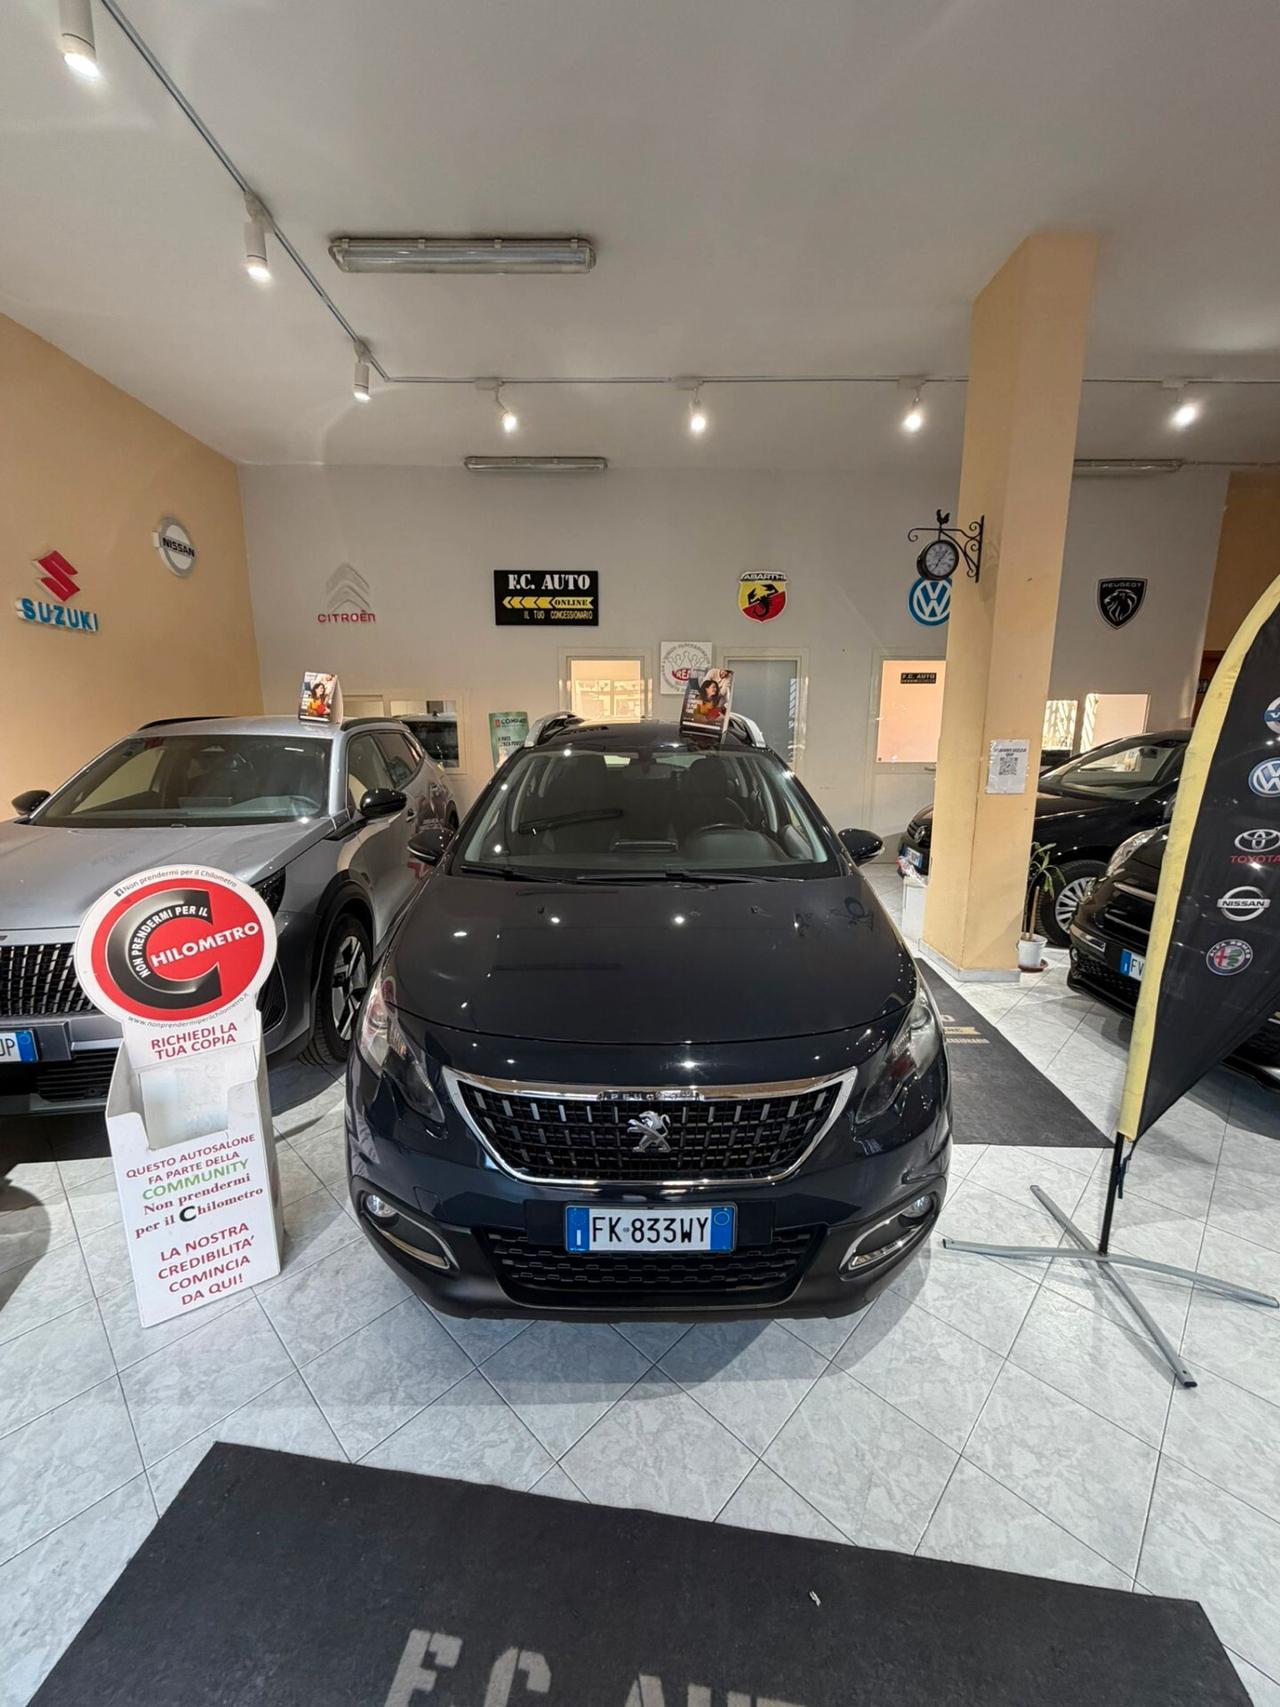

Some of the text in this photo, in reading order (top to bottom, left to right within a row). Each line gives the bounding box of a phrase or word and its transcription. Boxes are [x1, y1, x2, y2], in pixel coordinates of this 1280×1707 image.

[163, 537, 195, 558] NISSAN
[508, 574, 590, 590] F.C. AUTO
[20, 597, 98, 632] SUZUKI
[534, 610, 545, 619] TUO
[551, 610, 593, 619] CONCESSIONARIO
[554, 599, 588, 607] ONLINE
[123, 880, 139, 893] Non
[139, 868, 179, 888] prendermi
[180, 869, 193, 877] per
[200, 869, 238, 888] Chilometro
[131, 905, 209, 978] NON PRENDERMI PER IL
[150, 1022, 238, 1051] RICHIEDI LA
[155, 1033, 237, 1060] TUA COPIA
[126, 1134, 256, 1179] QUESTO AUTOSALONE
[148, 1151, 240, 1185] FA PARTE DELLA
[142, 1158, 249, 1200] COMMUNITY
[143, 1172, 251, 1216] Non prendermi
[135, 1187, 264, 1239] per il Chilometro
[160, 1222, 249, 1262] LA NOSTRA
[169, 1255, 251, 1293] COMINCIA
[181, 1273, 244, 1305] DA QUI!
